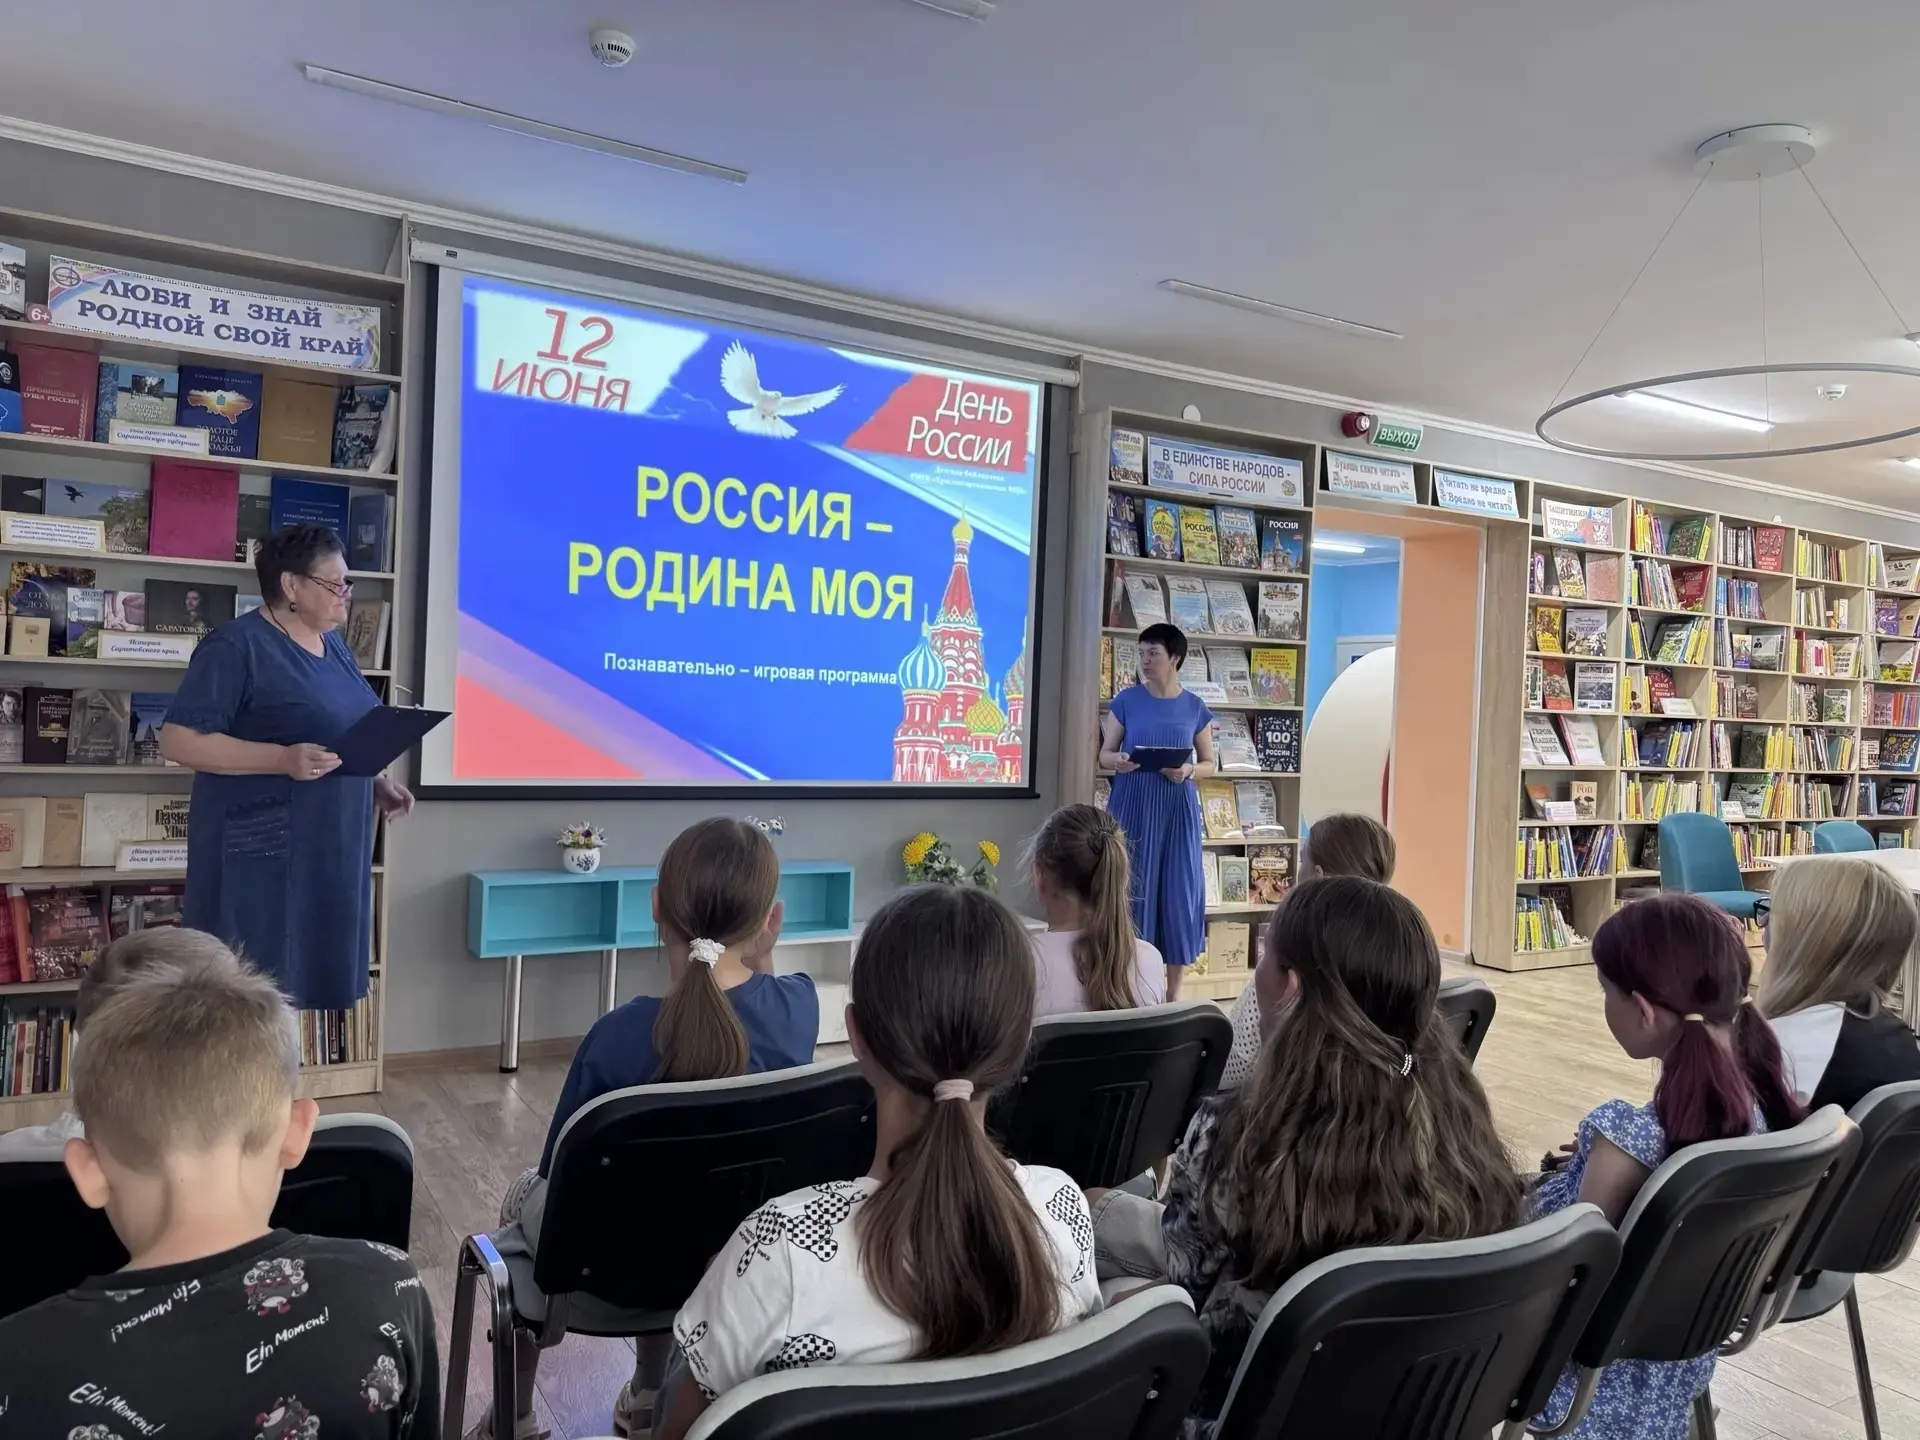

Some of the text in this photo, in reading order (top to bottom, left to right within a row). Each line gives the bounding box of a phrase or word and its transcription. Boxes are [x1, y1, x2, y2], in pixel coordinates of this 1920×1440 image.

[31, 308, 50, 321] 6+
[100, 279, 322, 328] ЛЮБИ И ЗНАЙ
[77, 299, 363, 357] РОДНОЙ СВОЙ КРАЙ
[537, 308, 615, 370] 12
[492, 358, 631, 412] ИЮНЯ
[935, 379, 1013, 425] День
[907, 415, 1012, 466] России
[1378, 427, 1417, 448] ВЫХОД
[1162, 448, 1170, 461] В
[1173, 450, 1230, 472] ЕДИНСТВЕ
[1232, 460, 1284, 479] НАРОДОВ
[1334, 457, 1358, 472] Будешь
[1379, 467, 1400, 478] читать
[1189, 471, 1266, 493] СИЛА РОССИИ
[1442, 474, 1469, 490] Читать
[1470, 483, 1479, 491] не
[1480, 484, 1506, 495] вредно
[637, 465, 852, 541] РОССИЯ
[1447, 492, 1476, 506] Вредно
[1487, 502, 1513, 511] читать
[1185, 523, 1213, 533] РОССИЯ
[1269, 520, 1298, 529] РОССИЯ
[568, 541, 914, 622] РОДИНА МОЯ
[111, 646, 160, 654] Саратовского
[603, 652, 735, 677] Познавательно
[754, 665, 815, 682] игровая
[818, 668, 897, 686] программа
[1266, 731, 1290, 743] 100
[111, 1278, 201, 1343] Ein Moment!
[246, 1306, 330, 1374] Ein Moment!
[68, 1382, 166, 1436] Ein Moment!
